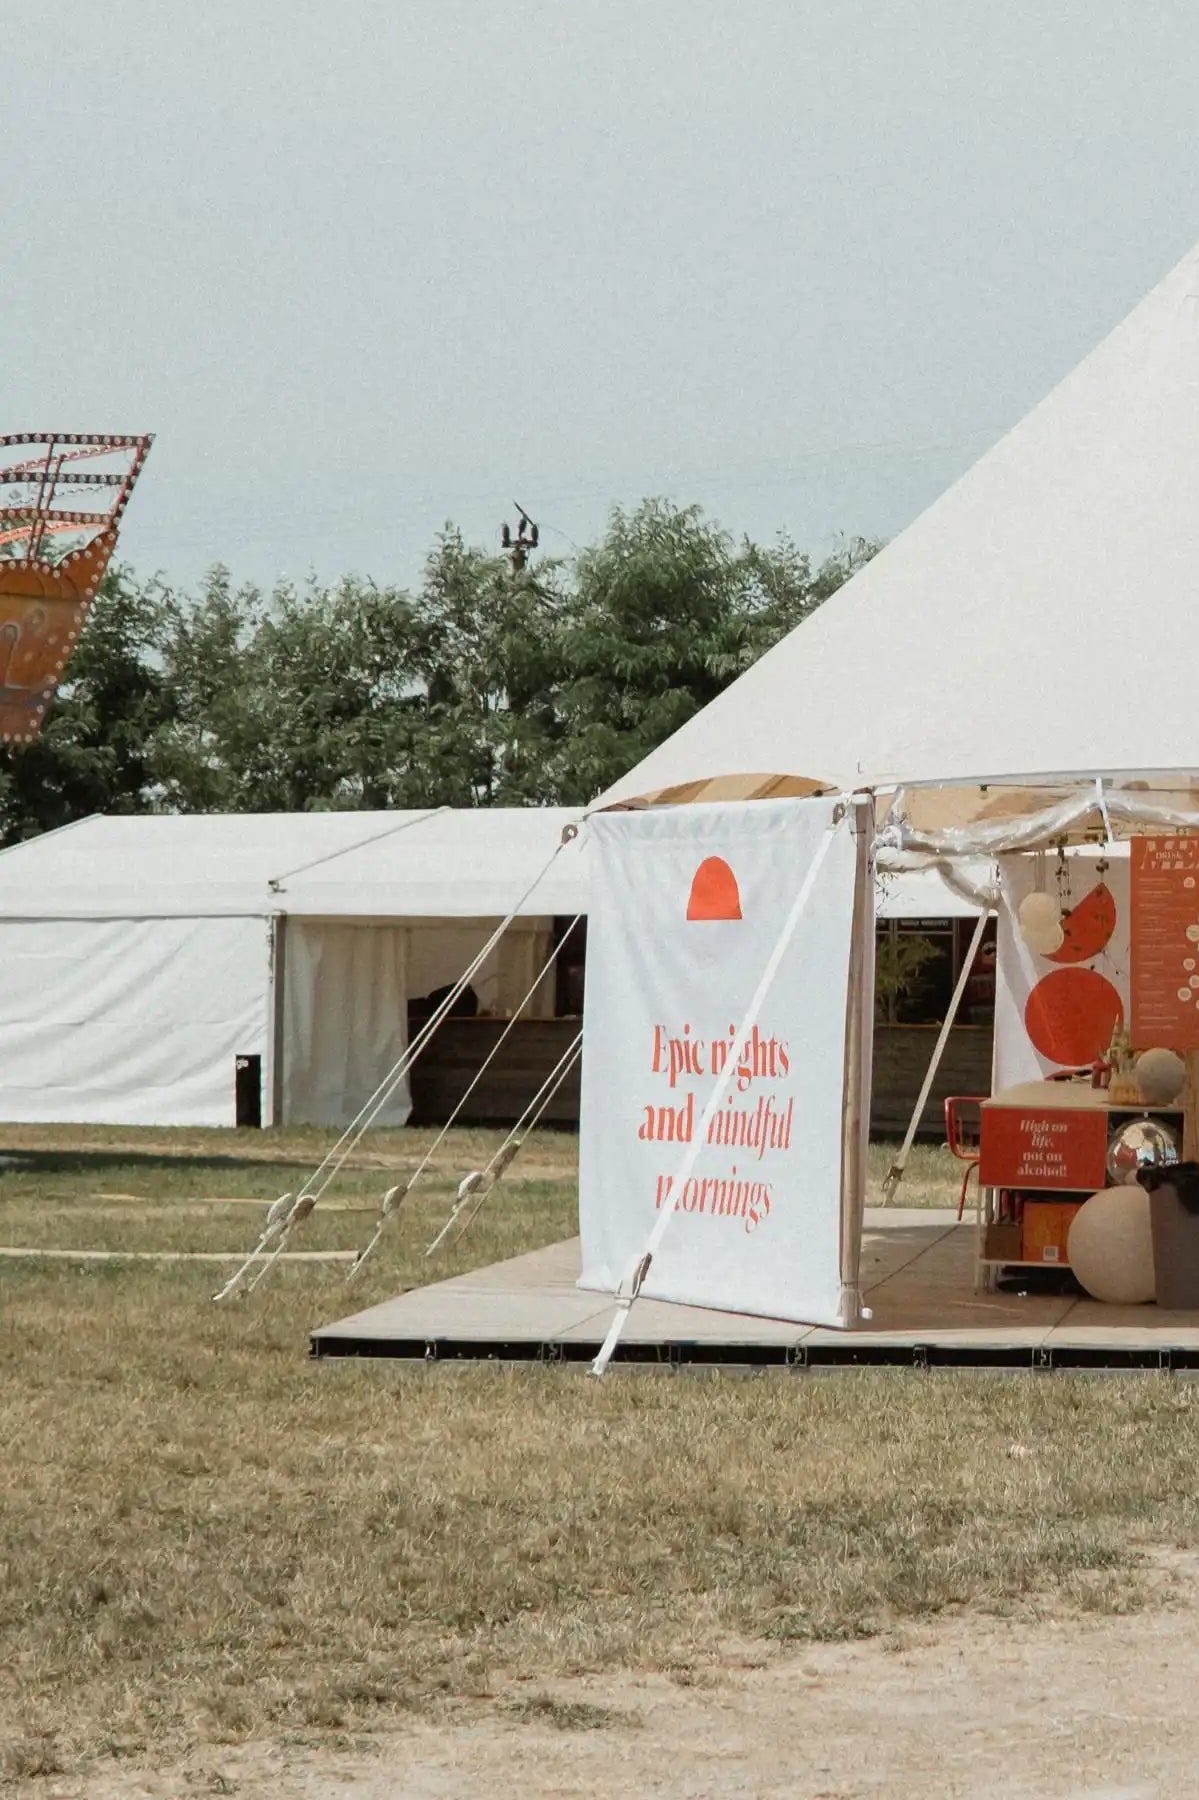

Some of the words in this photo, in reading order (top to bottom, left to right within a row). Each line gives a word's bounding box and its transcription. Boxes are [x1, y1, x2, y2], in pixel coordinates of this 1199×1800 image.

[652, 1023, 704, 1088] Epic
[638, 1092, 693, 1143] and
[1020, 1119, 1049, 1135] High
[1023, 1151, 1043, 1161] not
[1046, 1152, 1063, 1162] on
[1017, 1163, 1067, 1177] alcohol!
